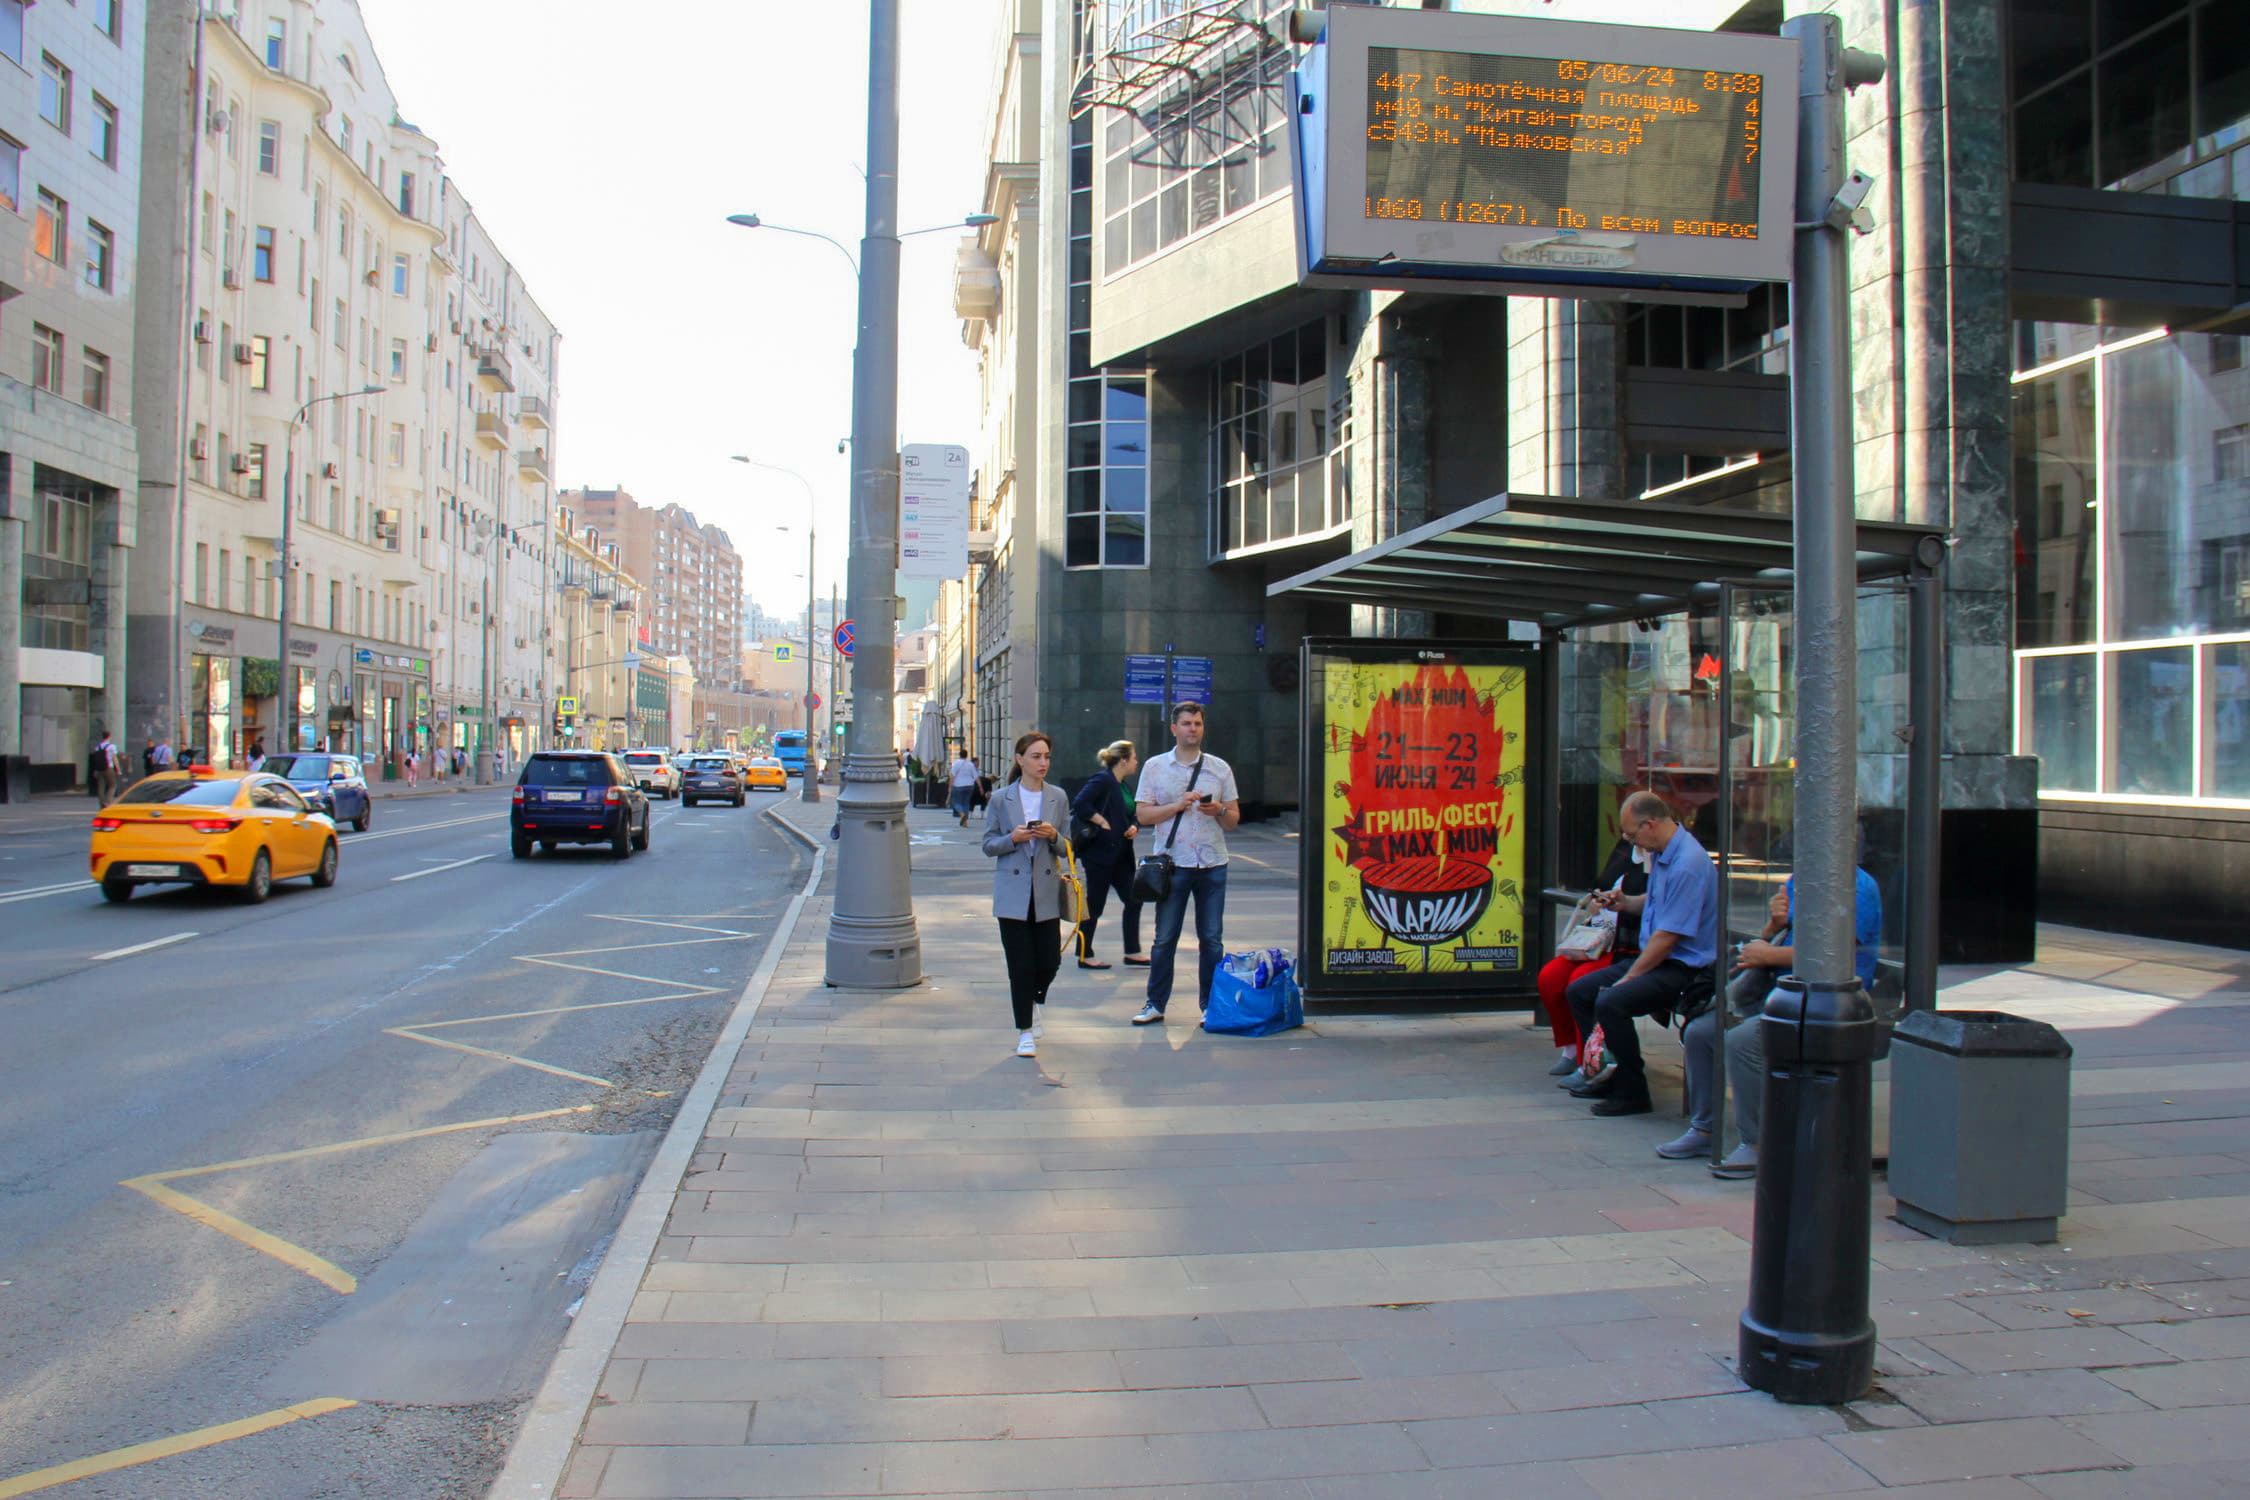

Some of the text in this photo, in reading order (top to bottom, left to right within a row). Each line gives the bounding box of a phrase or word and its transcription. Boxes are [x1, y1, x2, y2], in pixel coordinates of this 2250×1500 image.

[1557, 60, 1761, 94] 05/06/24 8:33
[1376, 72, 1760, 117] 447 Самотёчная площадь 4
[1744, 120, 1760, 141] 5
[1744, 143, 1759, 164] 7
[1557, 207, 1587, 228] По
[1601, 215, 1660, 233] всем
[1673, 219, 1758, 239] вопрос
[1375, 764, 1438, 790] ИЮНЯ
[1365, 801, 1499, 835] ГРИЛЬ ФЕСТ
[1364, 887, 1483, 933] ЖАРИМ
[1498, 929, 1519, 944] 18+
[1328, 950, 1394, 964] ДИЗАЙН ЗАВОД
